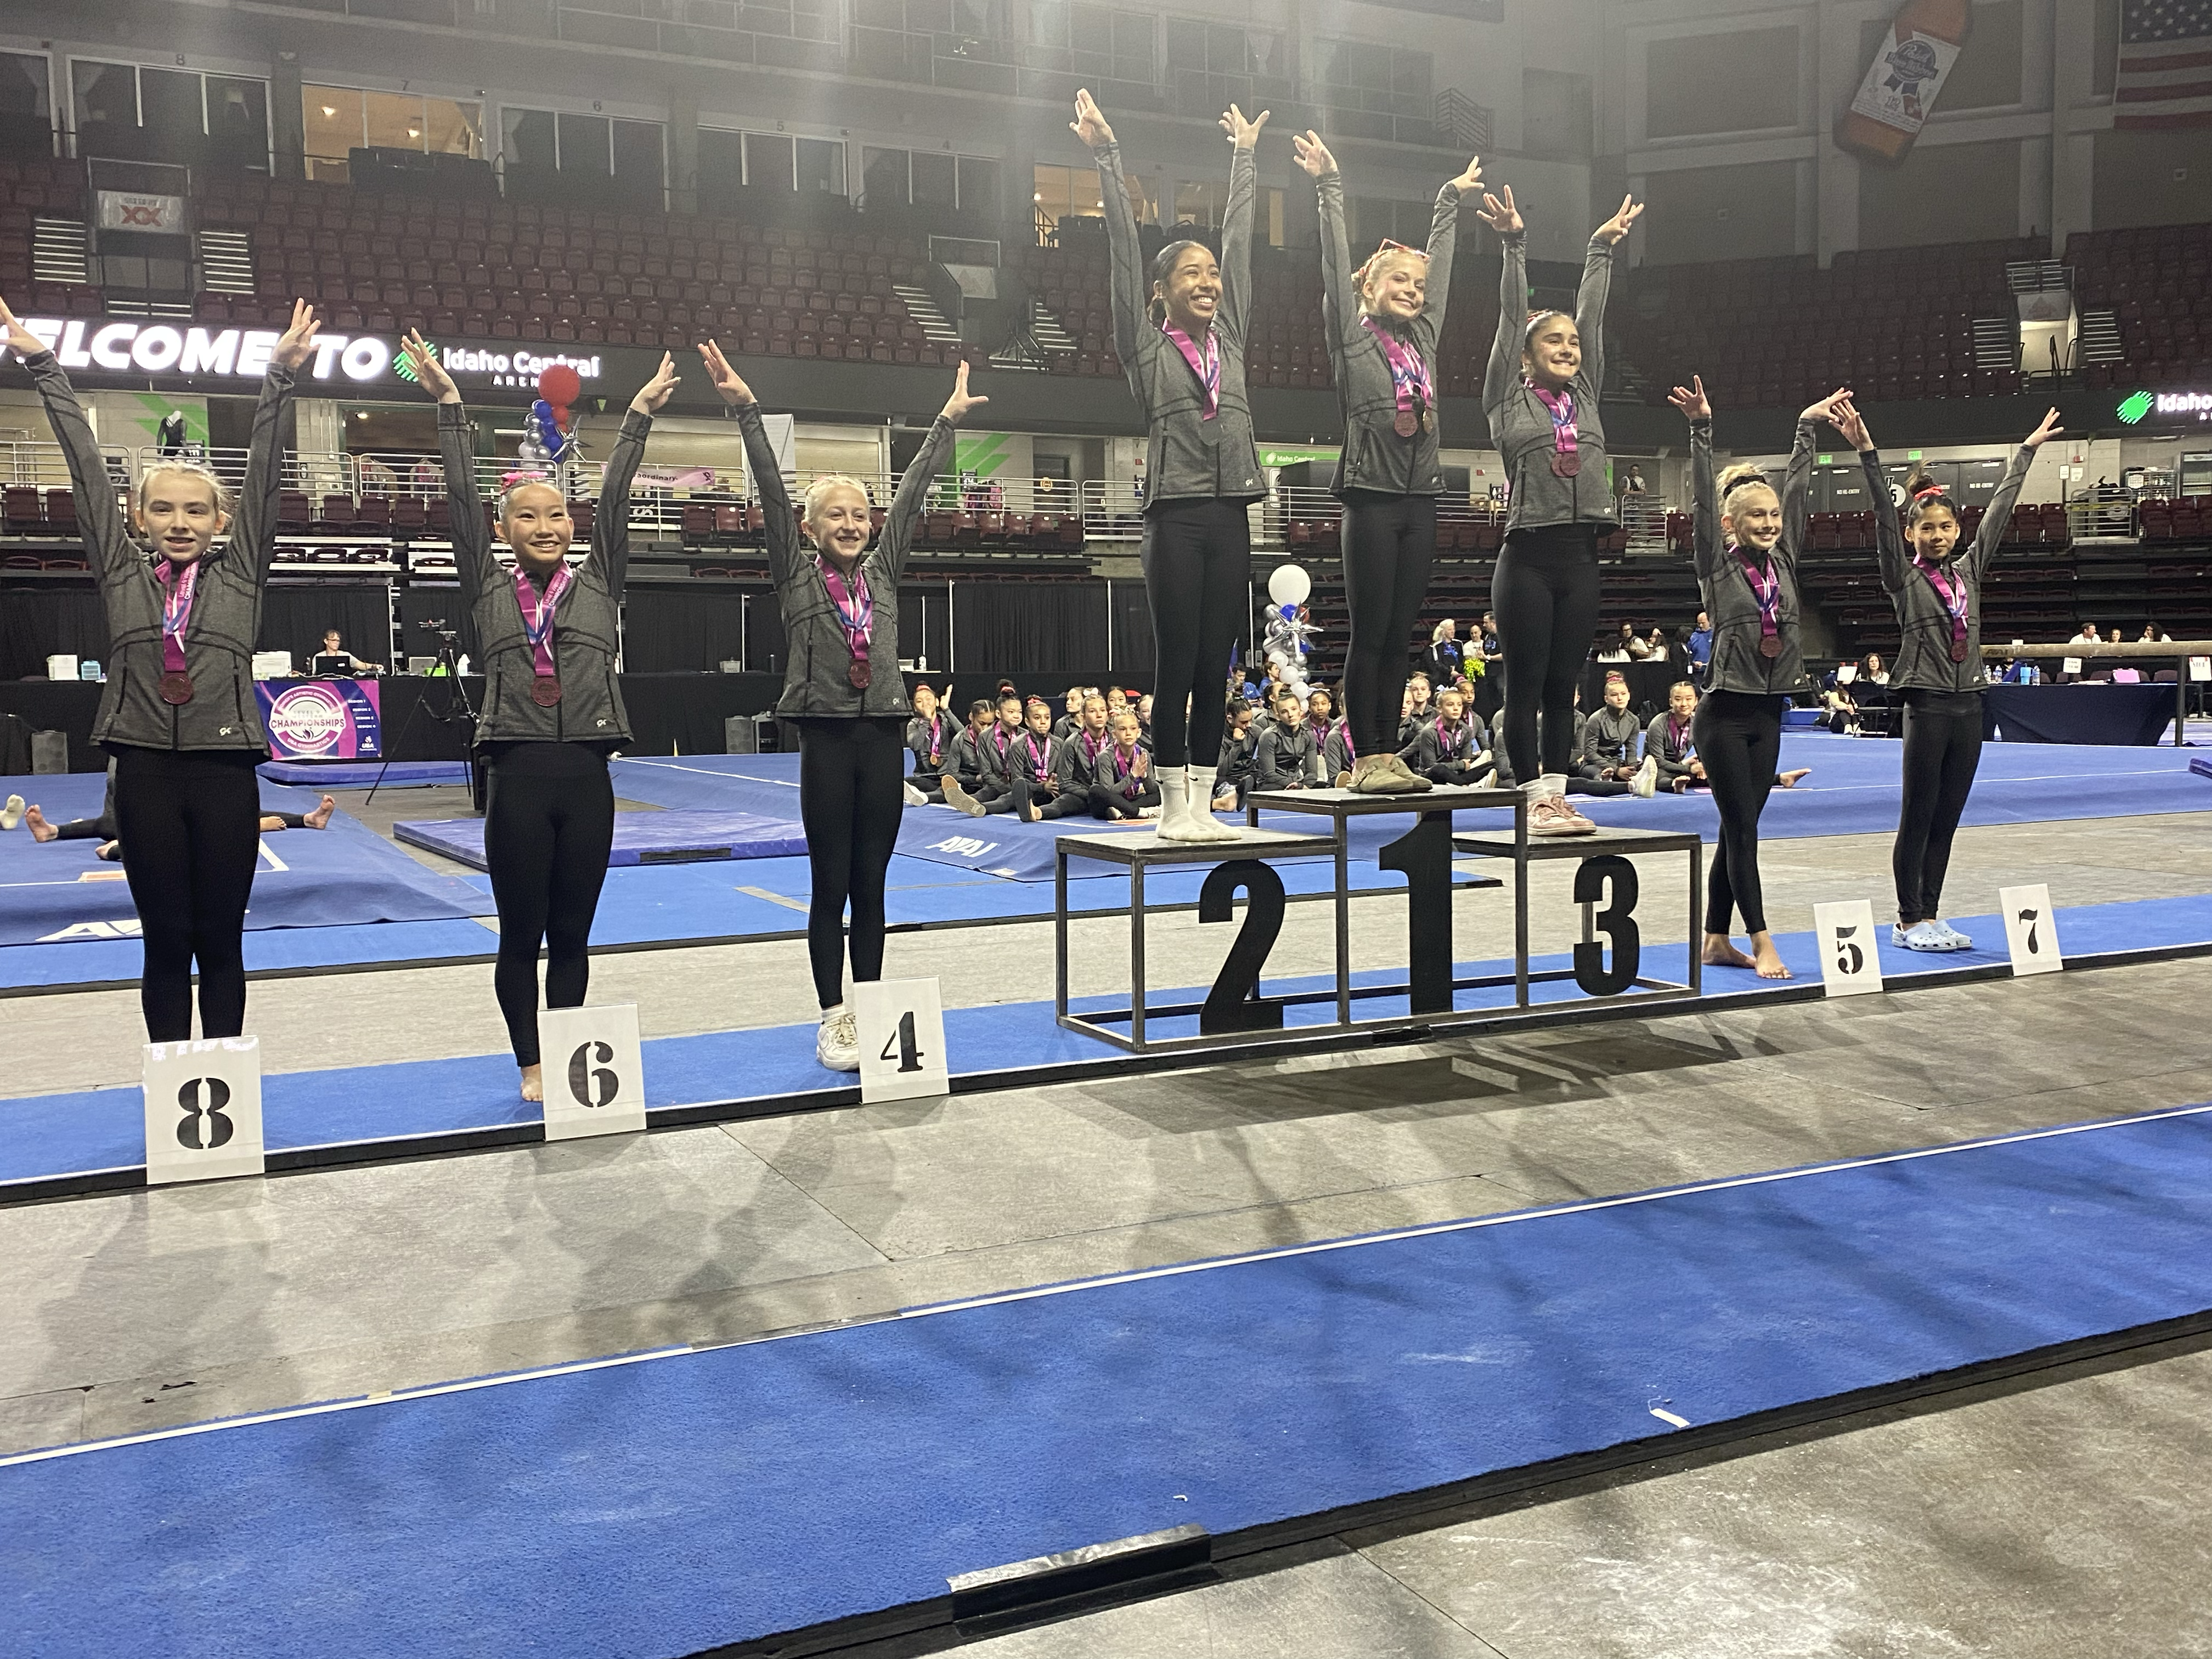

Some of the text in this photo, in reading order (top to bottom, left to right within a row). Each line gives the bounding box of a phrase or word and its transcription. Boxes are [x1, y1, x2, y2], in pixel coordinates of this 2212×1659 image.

[176, 54, 185, 65] 8
[400, 80, 409, 91] 7
[593, 101, 602, 111] 6
[777, 121, 784, 131] 5
[310, 334, 387, 380] TO
[443, 347, 509, 373] Idaho
[492, 374, 539, 388] AREN
[2157, 392, 2212, 412] Idaho
[270, 718, 345, 729] CHAMPIONSHIPS
[1379, 810, 1453, 1015] 1
[1573, 854, 1640, 996] 3
[2018, 909, 2039, 955] 7
[1199, 859, 1286, 1036] 2
[1836, 925, 1864, 975] 5
[880, 1011, 924, 1073] 4
[568, 1041, 619, 1108] 6
[177, 1077, 234, 1150] 8
